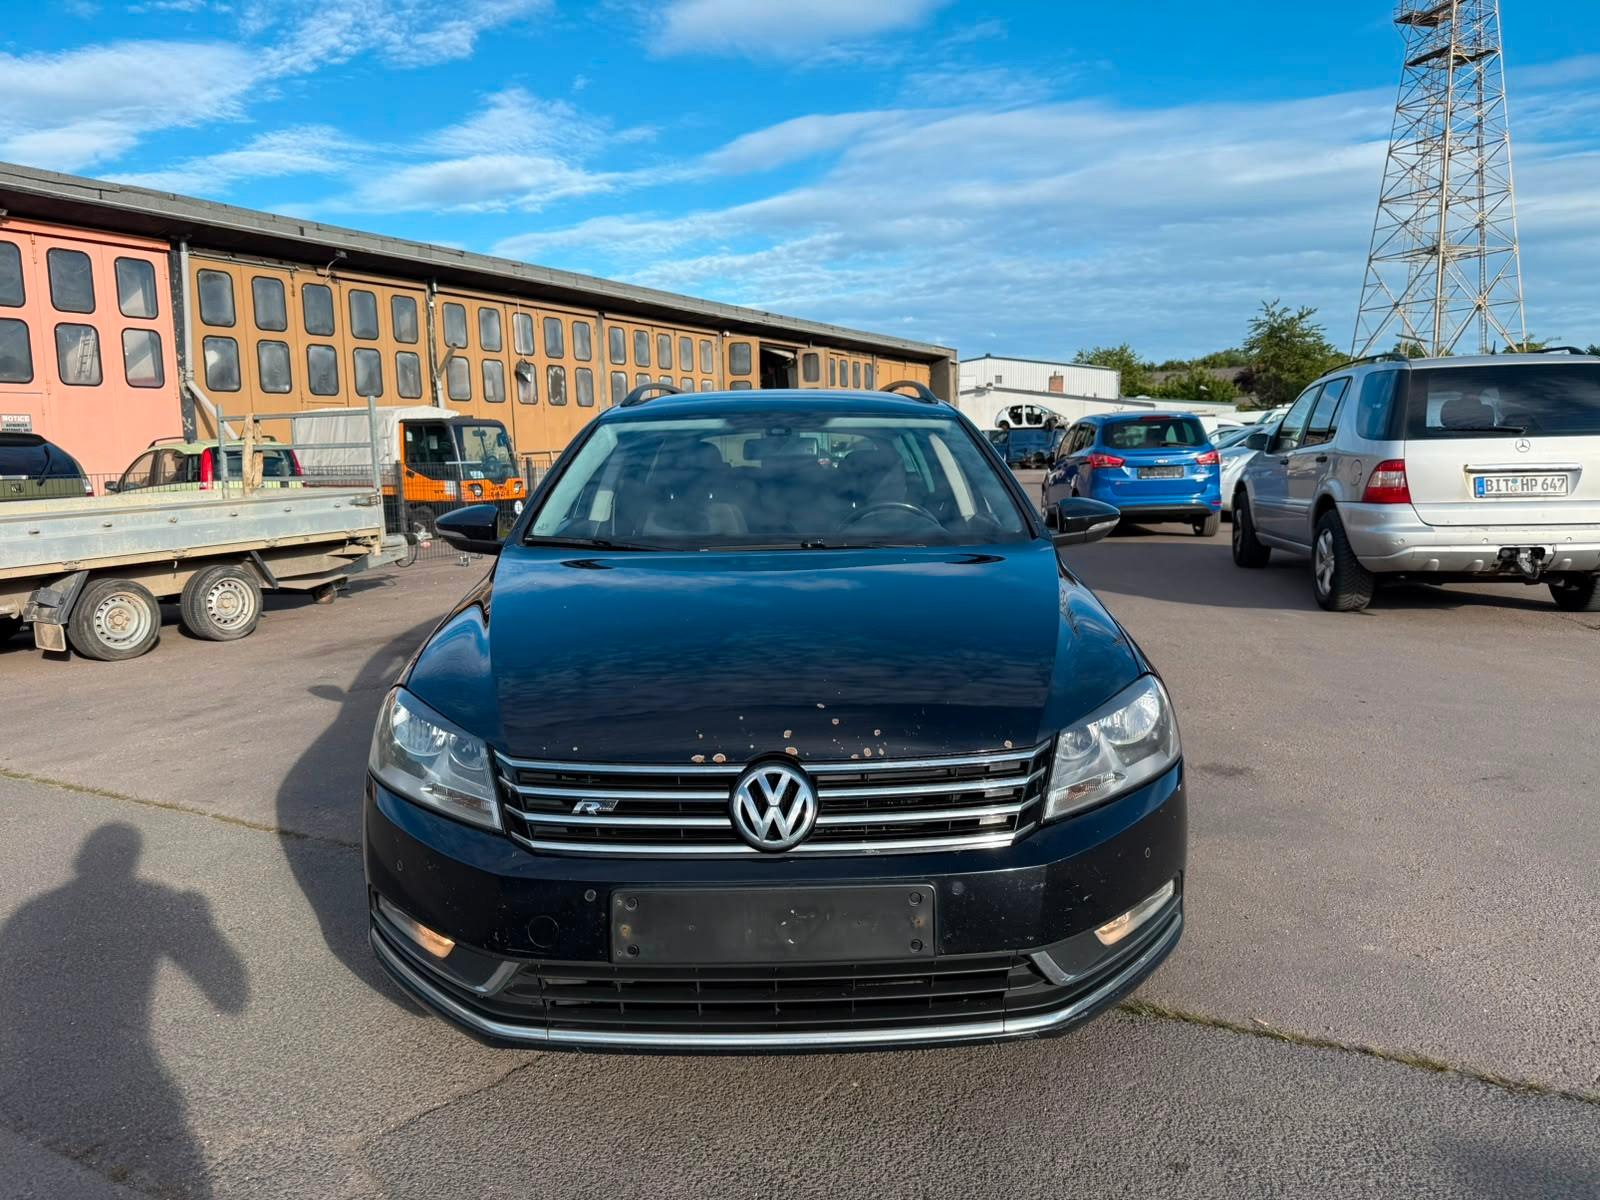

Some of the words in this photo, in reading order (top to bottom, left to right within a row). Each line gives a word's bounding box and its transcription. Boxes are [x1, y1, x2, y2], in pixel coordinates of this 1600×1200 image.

[1486, 479, 1510, 492] BIT
[1521, 478, 1538, 491] HP
[1541, 478, 1565, 491] 647
